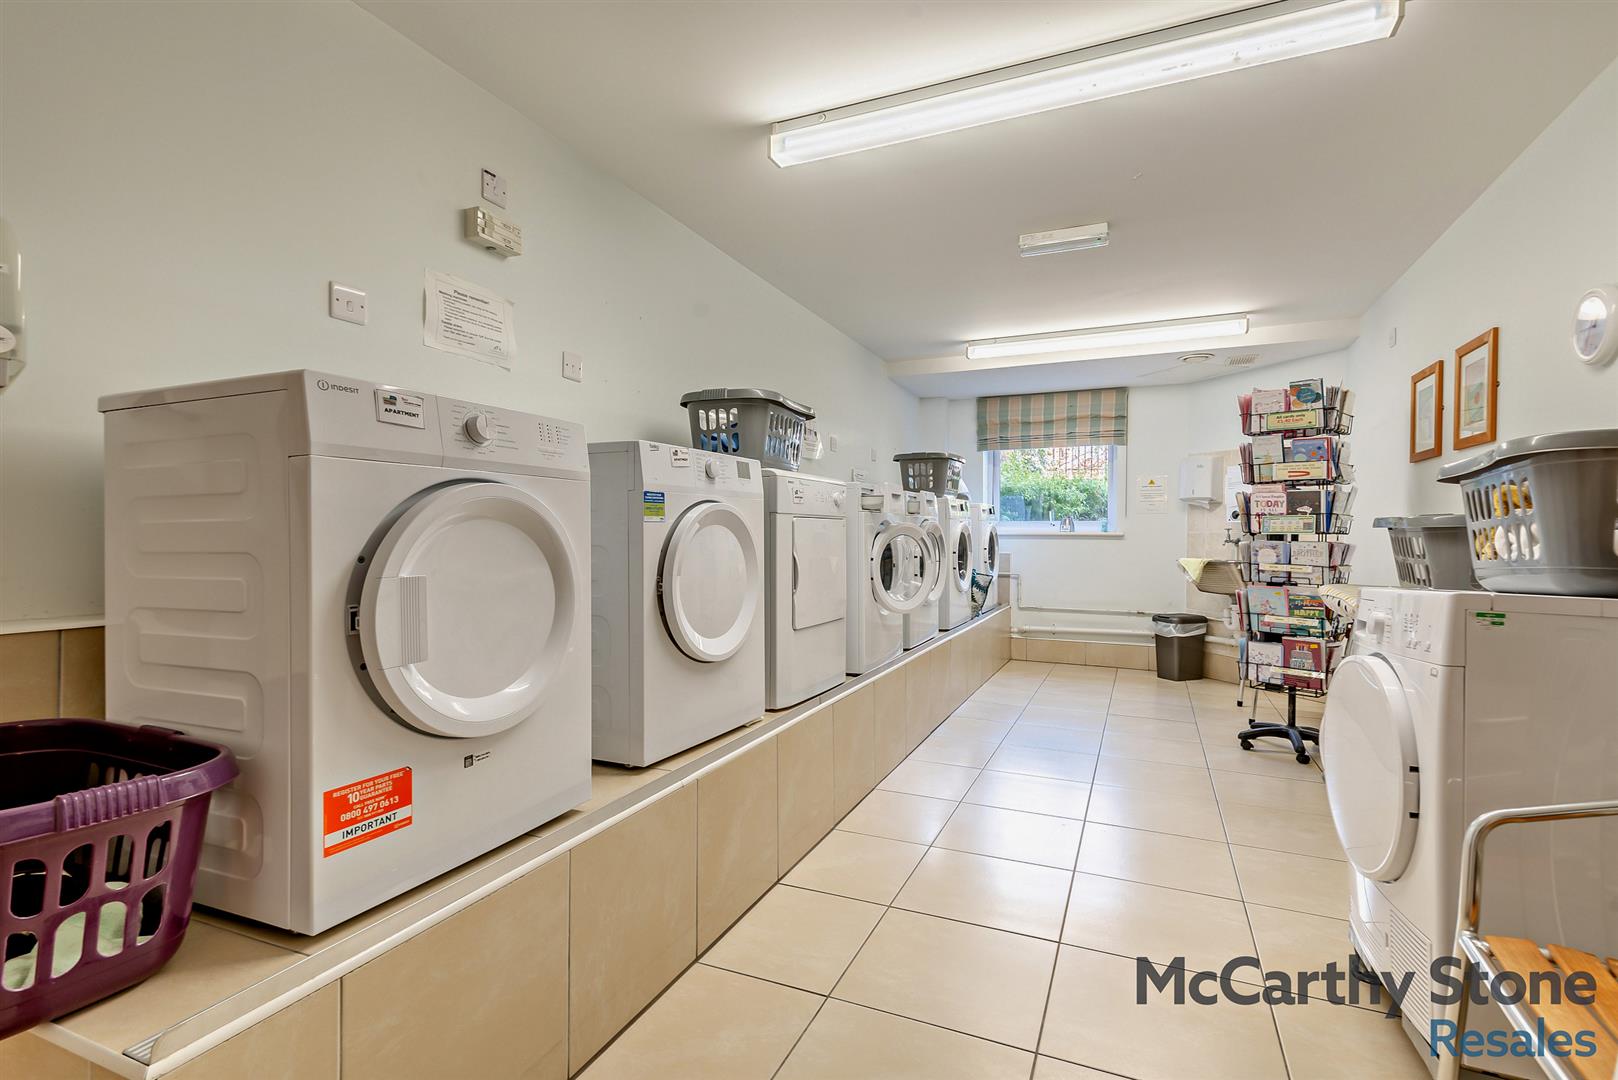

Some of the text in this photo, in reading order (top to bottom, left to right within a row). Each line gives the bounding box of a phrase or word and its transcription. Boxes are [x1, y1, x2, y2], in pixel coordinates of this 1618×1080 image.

[384, 407, 420, 418] APARTMENT
[1254, 499, 1285, 508] TODAY
[1293, 609, 1320, 617] HAPPY
[362, 780, 374, 788] FOR
[374, 775, 389, 784] YOUR
[389, 771, 404, 780] FREE
[360, 780, 393, 795] YEAR PARTS
[347, 791, 360, 804] 10
[340, 808, 362, 822] 0800
[379, 795, 399, 809] 0613
[341, 811, 398, 839] IMPORTANT
